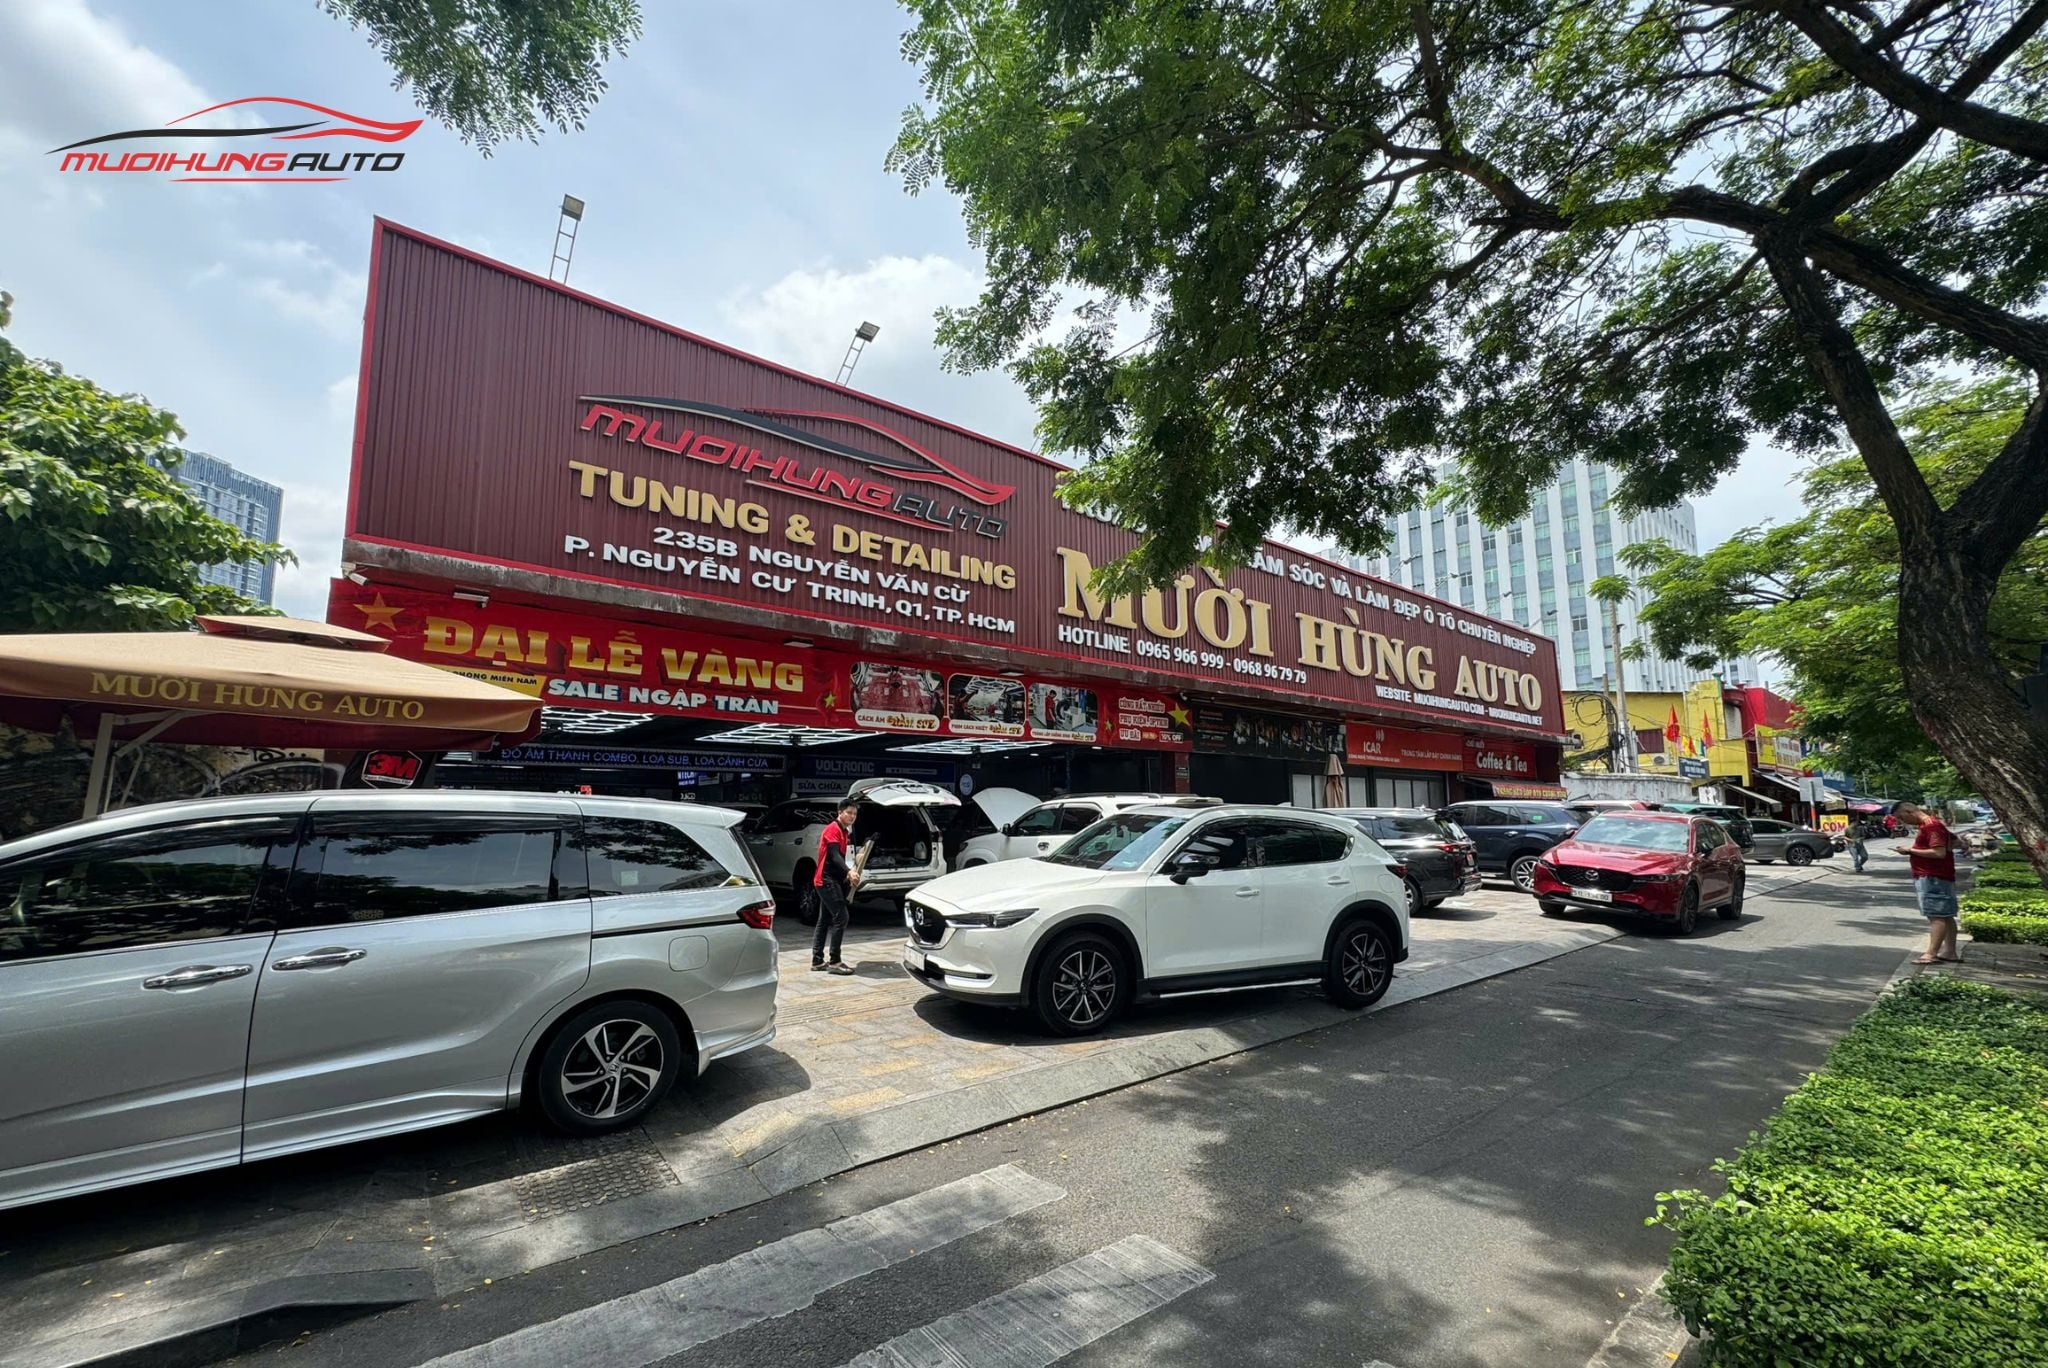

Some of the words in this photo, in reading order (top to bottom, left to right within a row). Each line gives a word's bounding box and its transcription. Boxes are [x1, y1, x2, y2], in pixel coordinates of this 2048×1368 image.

[568, 460, 769, 534] TUNING
[784, 513, 817, 547] &
[832, 523, 1017, 590] DETAILING
[564, 534, 595, 558] P.
[602, 542, 741, 584] NGUYỄN
[751, 571, 797, 593] CƯ
[653, 526, 739, 557] 235B
[749, 545, 870, 585] NGUYỄN
[876, 571, 929, 596] VĂN
[933, 583, 971, 603] CỪ
[1288, 562, 1326, 590] SÓC
[1330, 575, 1352, 599] VÀ
[1355, 584, 1389, 611] LÀM
[1393, 598, 1421, 621] ĐẸP
[1423, 605, 1435, 624] Ô
[1437, 612, 1456, 631] TÔ
[1457, 619, 1502, 645] CHUYÊN
[1502, 632, 1537, 657] NGHIỆP
[1057, 546, 1274, 657] MƯỜI
[1295, 607, 1437, 691] HÙNG
[1454, 655, 1543, 711] AUTO
[423, 616, 549, 666] ĐẠI
[569, 629, 643, 676] LỄ
[660, 648, 804, 692] VÀNG
[1136, 639, 1171, 660] 0965
[1173, 646, 1198, 665] 966
[1200, 652, 1224, 669] 999
[1233, 658, 1262, 676] 0968
[516, 677, 537, 686] NAM
[547, 679, 621, 702] SALE
[628, 686, 707, 711] NGẬP
[712, 694, 779, 715] TRÀN
[332, 695, 425, 720] AUTO
[548, 750, 590, 761] THANH
[643, 754, 665, 765] LOA
[695, 756, 716, 766] LOA
[1363, 741, 1381, 754] ICAR
[1476, 751, 1504, 770] Coffee
[1505, 754, 1512, 770] &
[1512, 755, 1528, 773] Tea
[368, 754, 417, 779] 3M
[815, 759, 875, 773] VOLTRONIC
